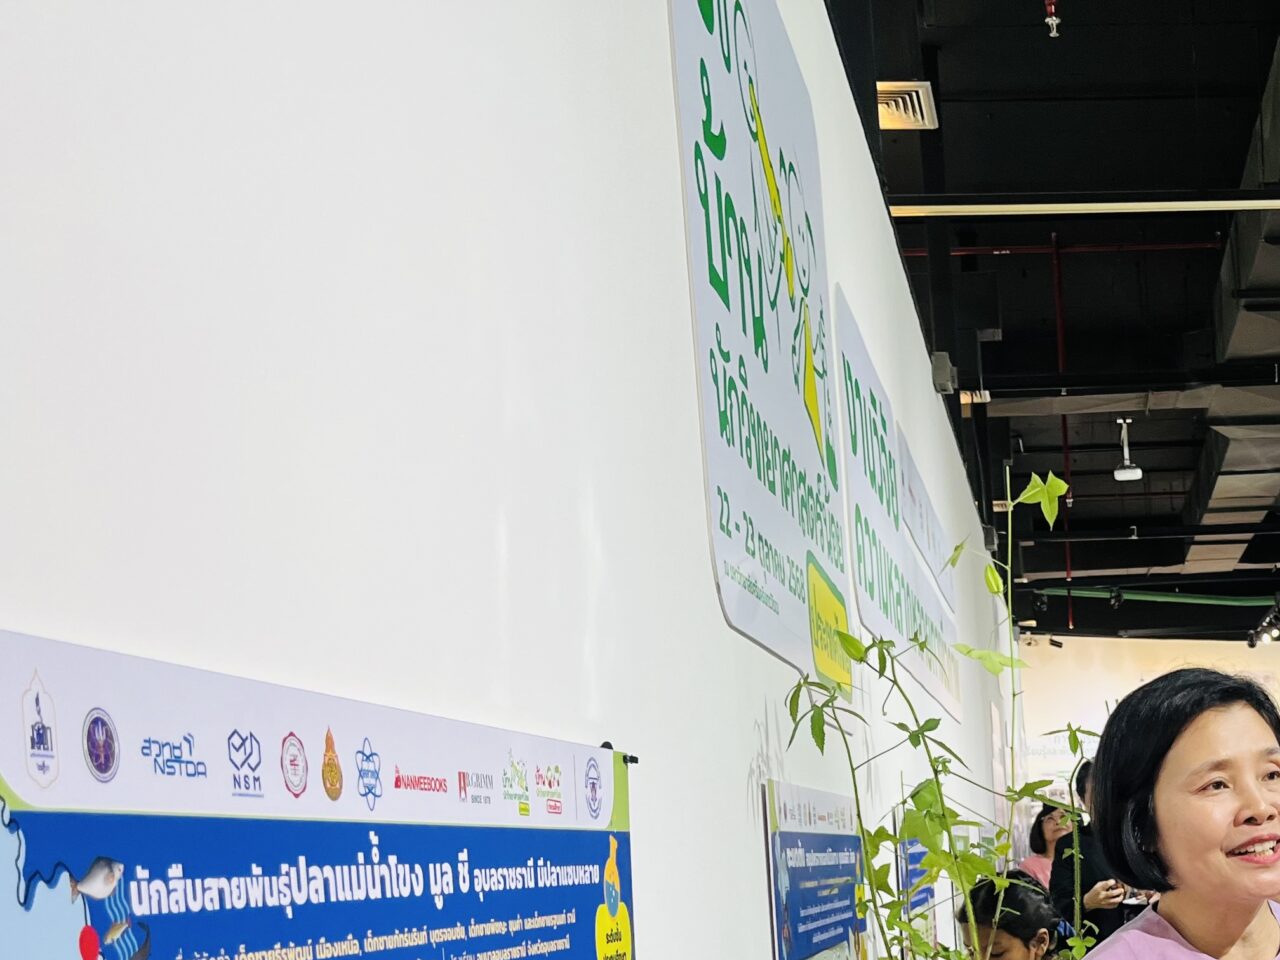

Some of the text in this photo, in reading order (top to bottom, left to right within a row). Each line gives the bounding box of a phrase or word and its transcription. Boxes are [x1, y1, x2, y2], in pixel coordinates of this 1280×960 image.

[694, 57, 768, 374] บ้าน
[710, 322, 845, 575] นักวิทยาศาสตร์น้อย
[841, 351, 900, 532] งานวิจัย
[716, 485, 732, 539] 22
[742, 510, 755, 560] 23
[757, 531, 786, 588] ตุลาคม
[786, 554, 806, 605] 2568
[153, 758, 208, 778] NSTDA
[233, 774, 262, 791] NSM
[401, 774, 448, 794] NANMEEBOOKS
[129, 830, 600, 919] นักสืบสายพันธุ์ปลาแม่น้ำโขง มูล ชี อุบลราชธานี มีปลาแซบหลาย
[316, 933, 363, 960] เมืองเหนือ,
